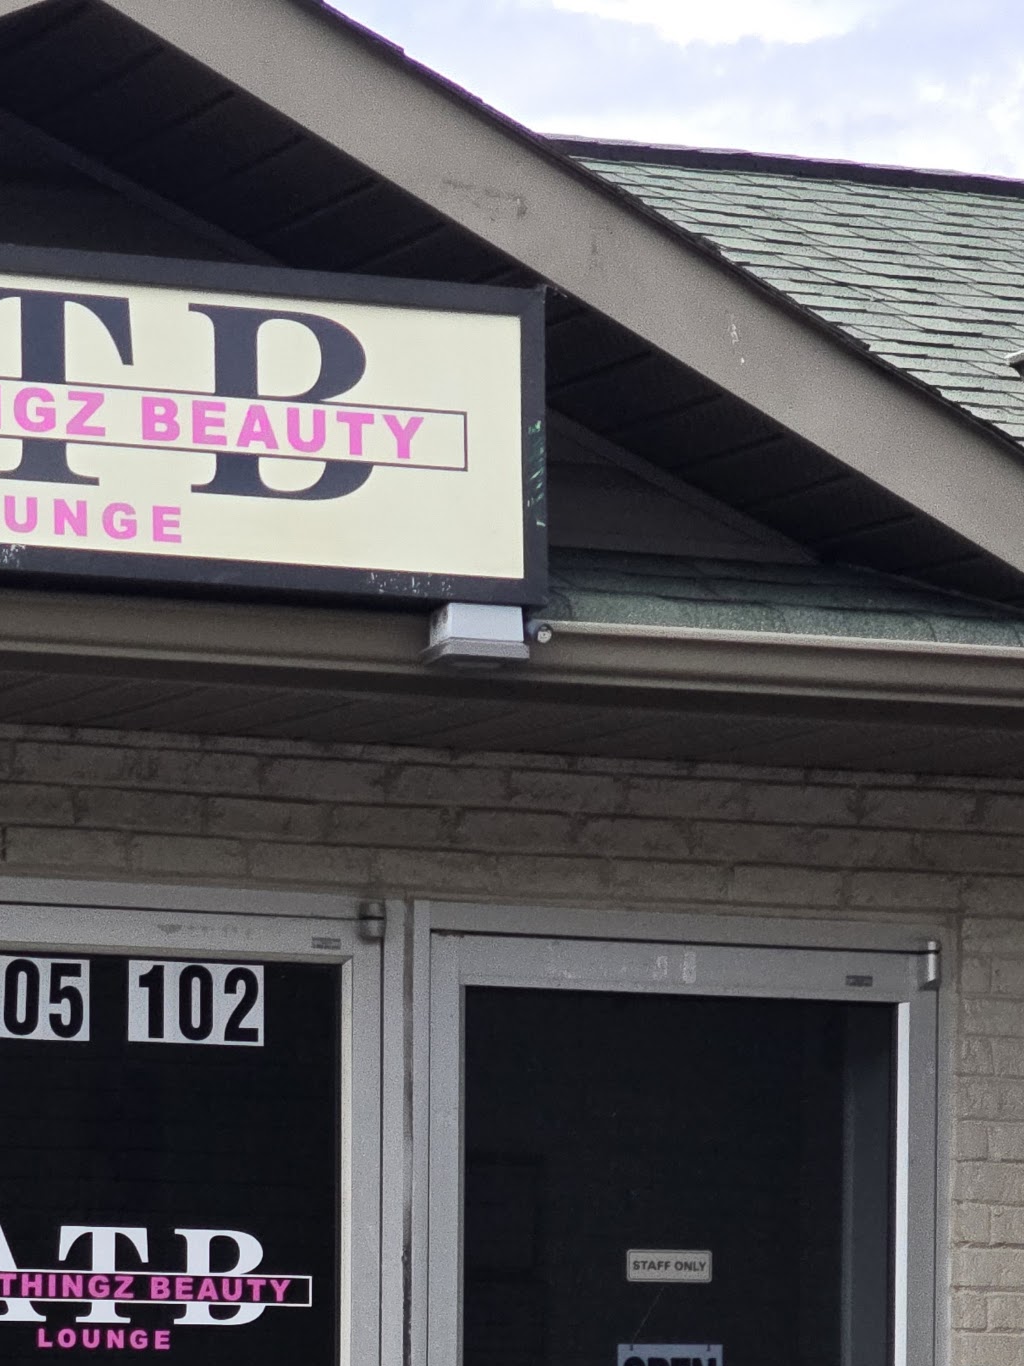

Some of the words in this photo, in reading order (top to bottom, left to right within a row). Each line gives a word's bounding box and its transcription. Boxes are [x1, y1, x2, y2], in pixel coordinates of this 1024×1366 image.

[140, 396, 424, 459] BEAUTY
[138, 964, 260, 1042] 102
[633, 1260, 671, 1271] STAFF
[674, 1261, 706, 1272] ONLY
[150, 1276, 292, 1302] BEAUTY
[37, 1328, 172, 1350] LOUNGE
